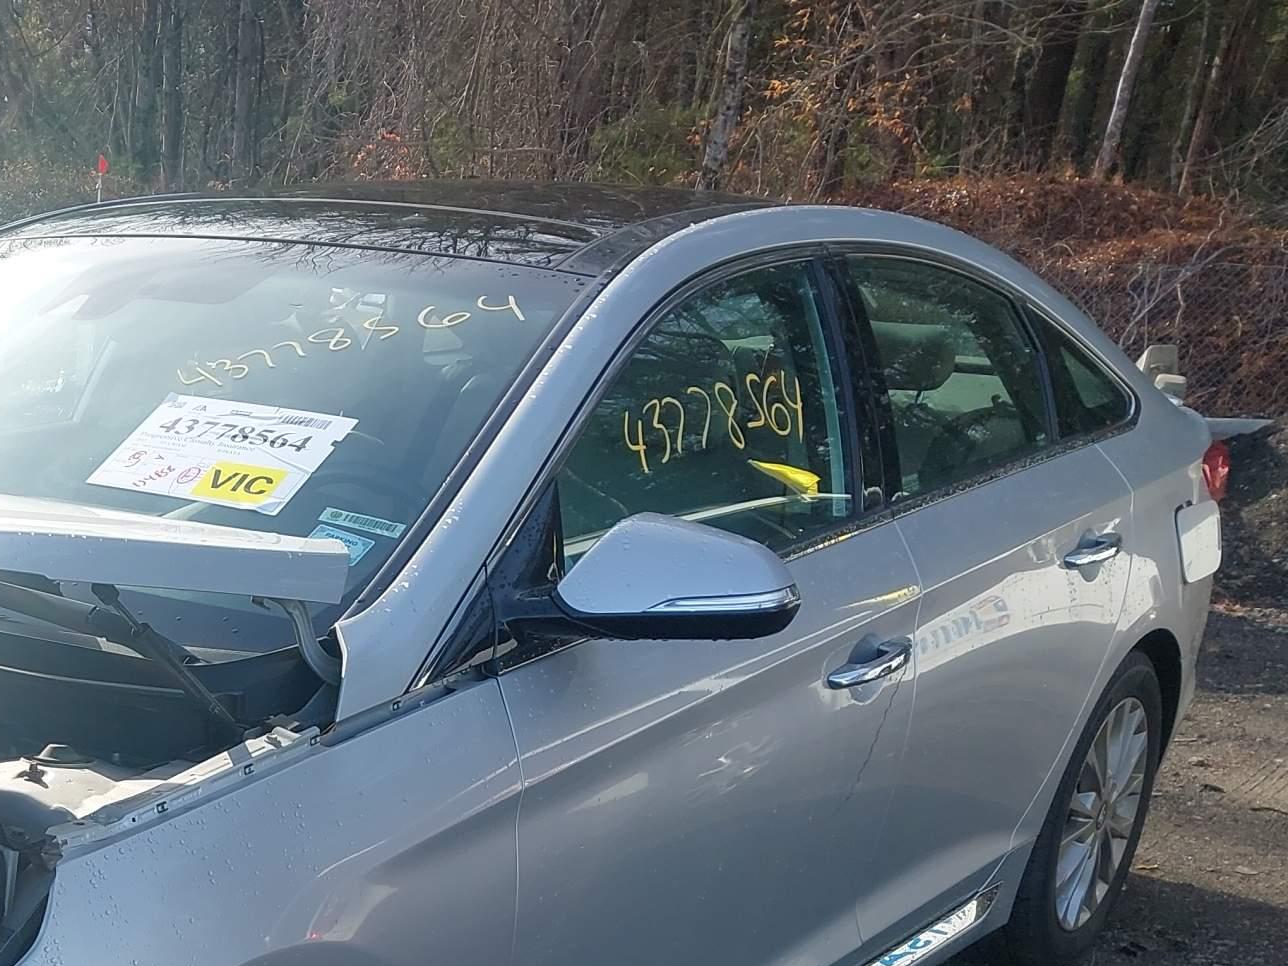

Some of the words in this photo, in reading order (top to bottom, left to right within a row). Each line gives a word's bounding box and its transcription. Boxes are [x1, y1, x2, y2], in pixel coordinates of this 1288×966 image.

[160, 417, 313, 453] 43778564
[624, 370, 804, 473] 43778564
[210, 469, 275, 496] VIC
